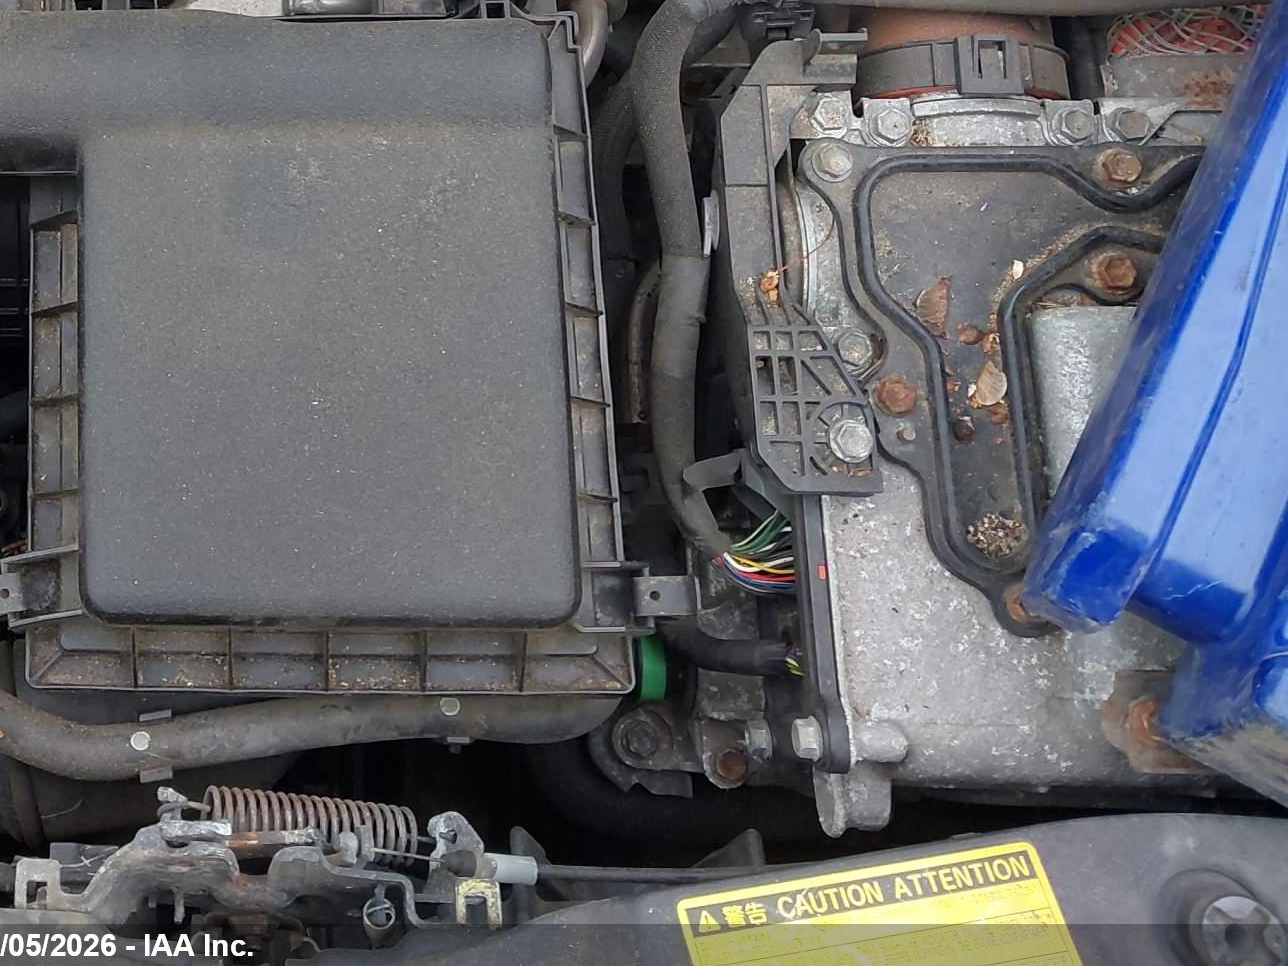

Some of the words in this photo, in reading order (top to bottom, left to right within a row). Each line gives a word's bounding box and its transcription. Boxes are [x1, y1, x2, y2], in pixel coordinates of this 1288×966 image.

[722, 901, 768, 927] 警告
[776, 880, 885, 920] CAUTION
[894, 854, 1030, 901] ATTENTION
